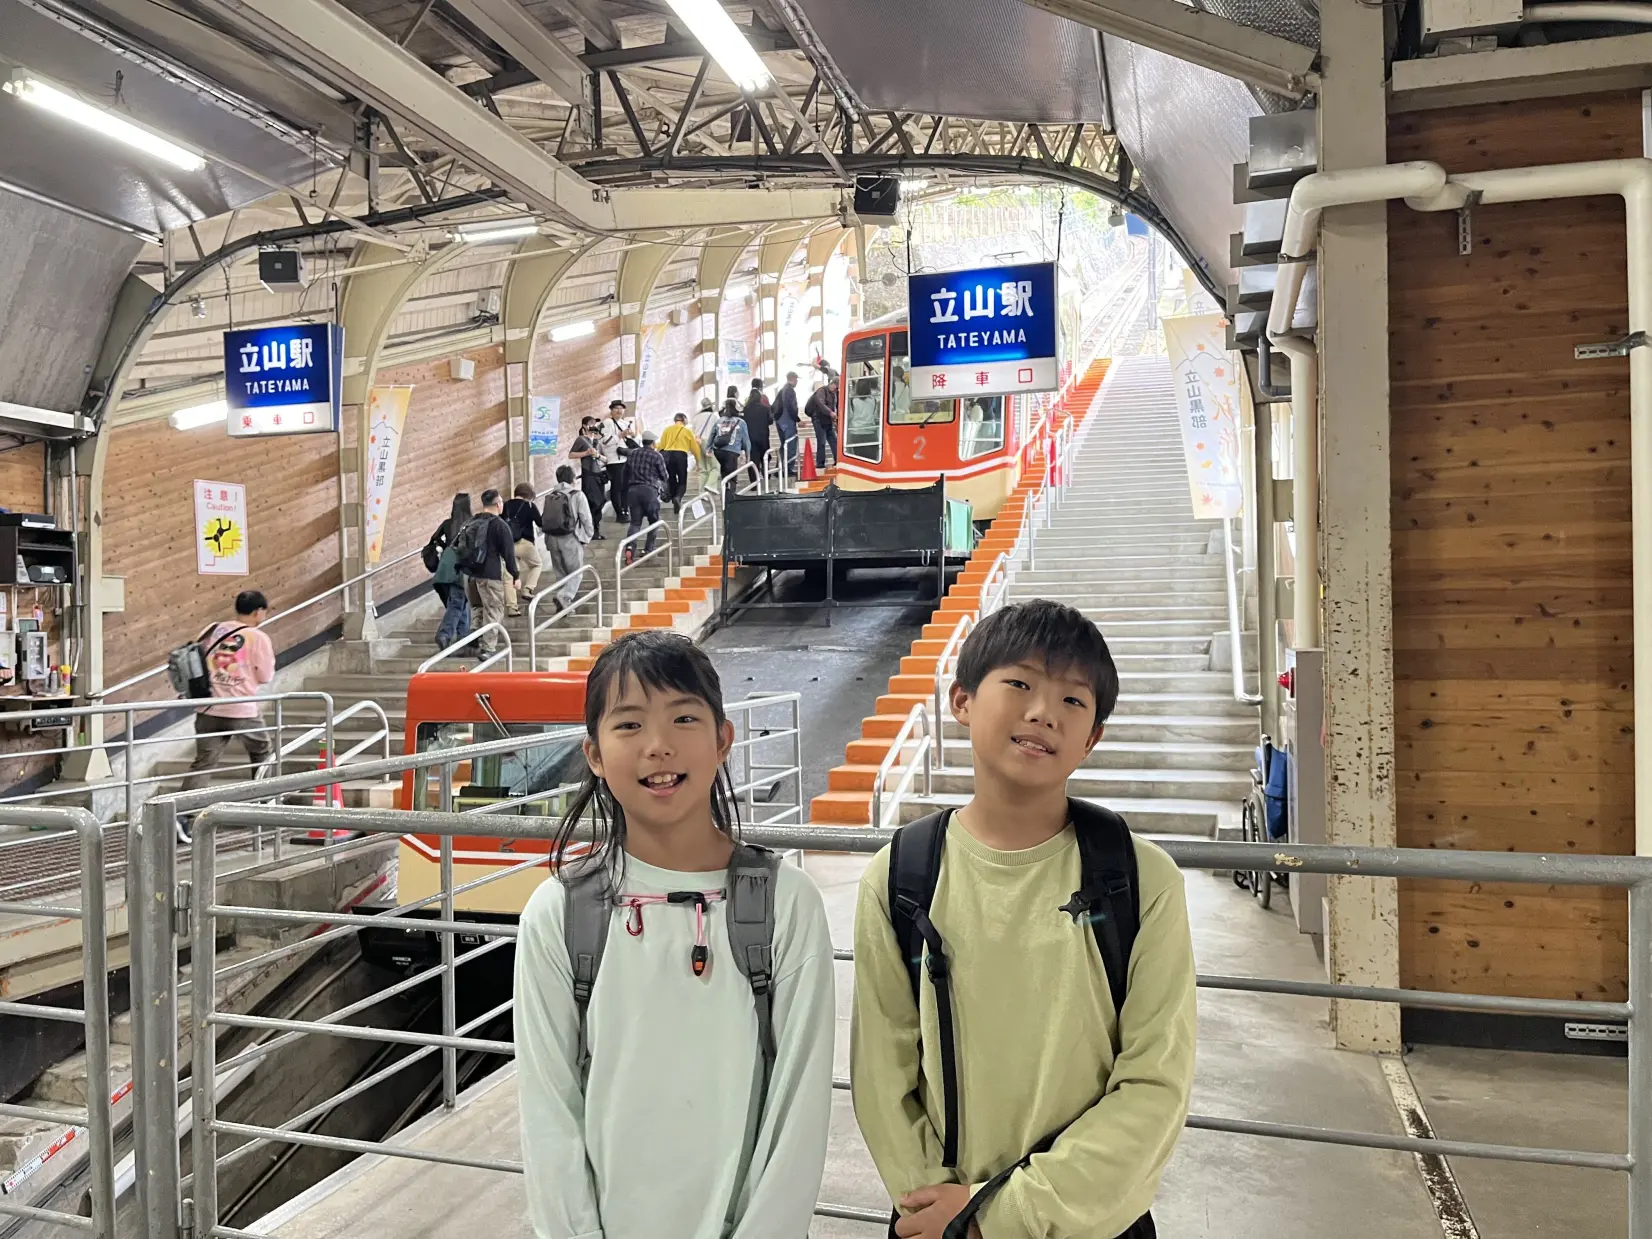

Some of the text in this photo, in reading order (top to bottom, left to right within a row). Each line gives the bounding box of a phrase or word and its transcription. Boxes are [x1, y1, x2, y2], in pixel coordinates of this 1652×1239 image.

[929, 280, 1034, 324] 立山駅
[937, 328, 1027, 349] TATEYAMA
[239, 338, 314, 373] 立山駅
[245, 378, 310, 395] TATEYAMA
[932, 368, 1033, 389] 降車口
[912, 436, 927, 460] 2
[376, 436, 391, 487] 立山黒部
